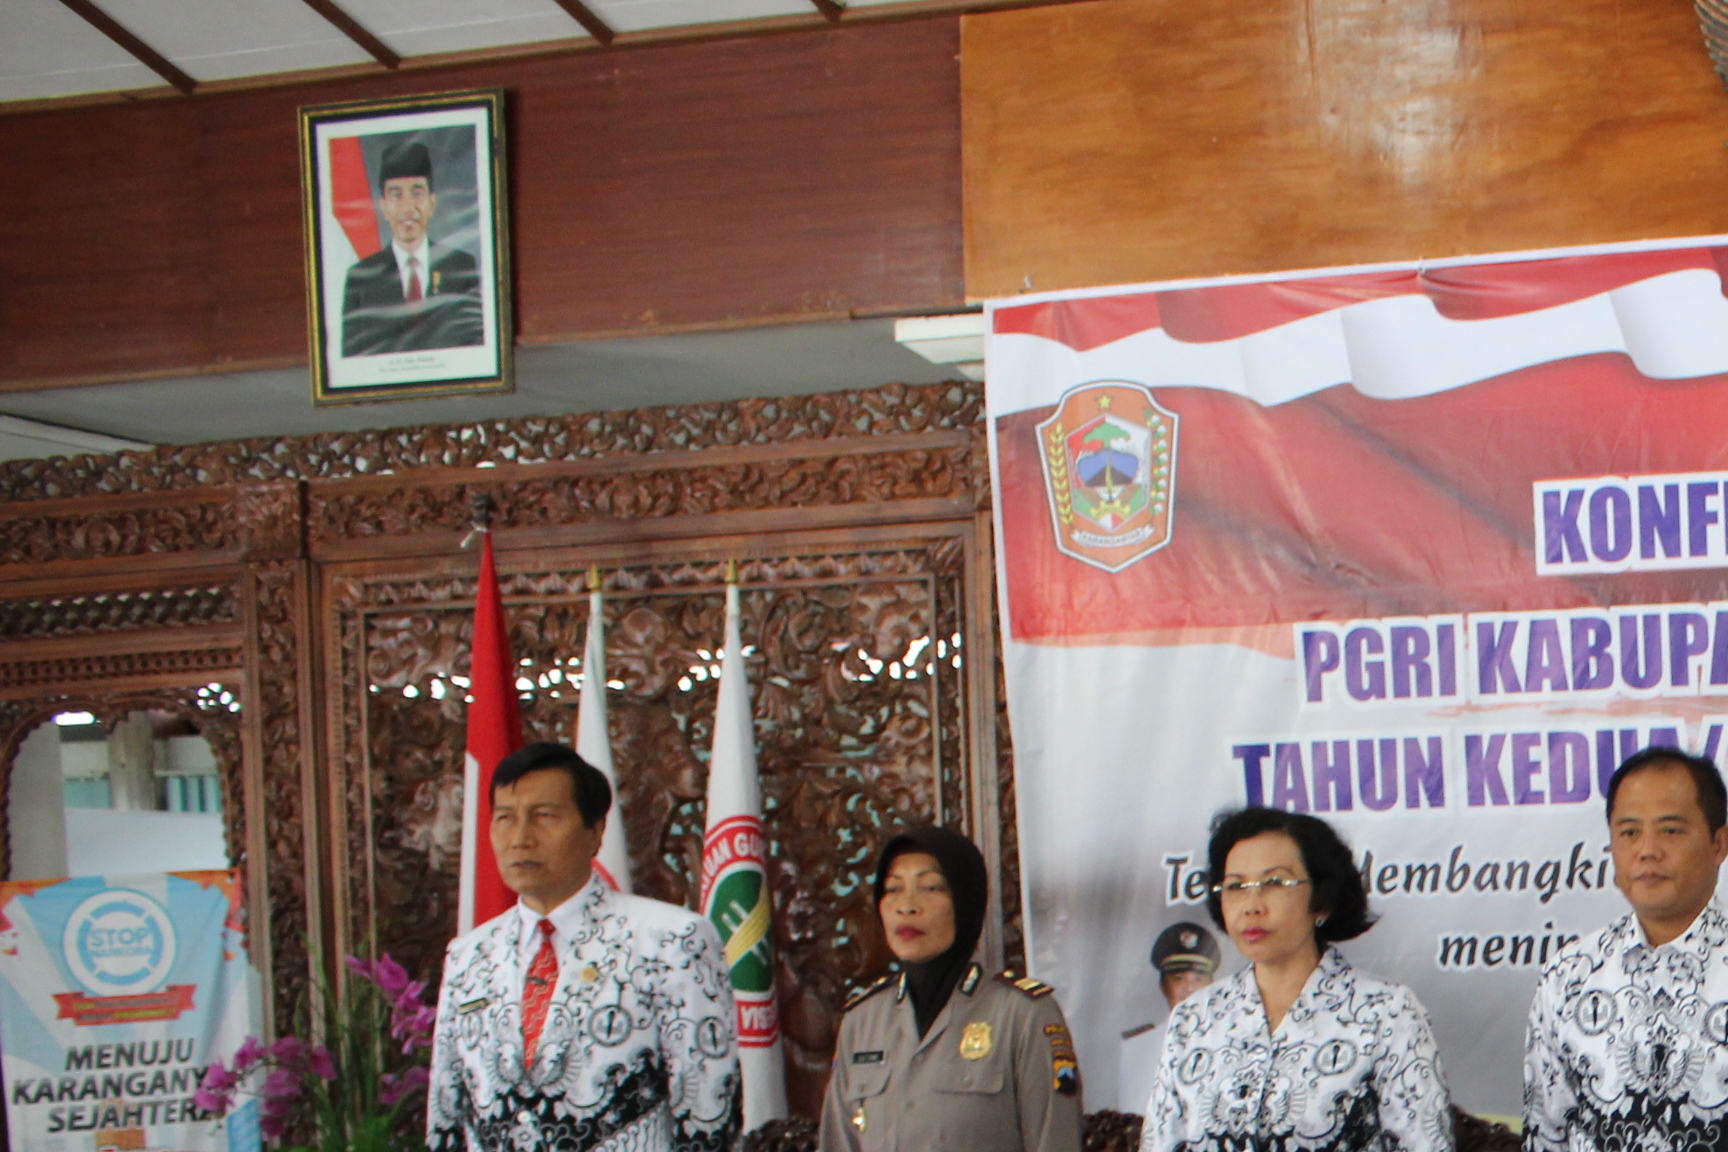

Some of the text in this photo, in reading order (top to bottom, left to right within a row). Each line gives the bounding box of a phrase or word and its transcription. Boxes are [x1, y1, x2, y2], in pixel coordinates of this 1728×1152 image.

[1302, 624, 1456, 702] PGRI
[1233, 735, 1445, 812] TAHUN
[1465, 727, 1681, 807] KEDU
[90, 926, 150, 947] STOP
[65, 1038, 194, 1071] MENUJU
[12, 1066, 209, 1104] KARANGANY
